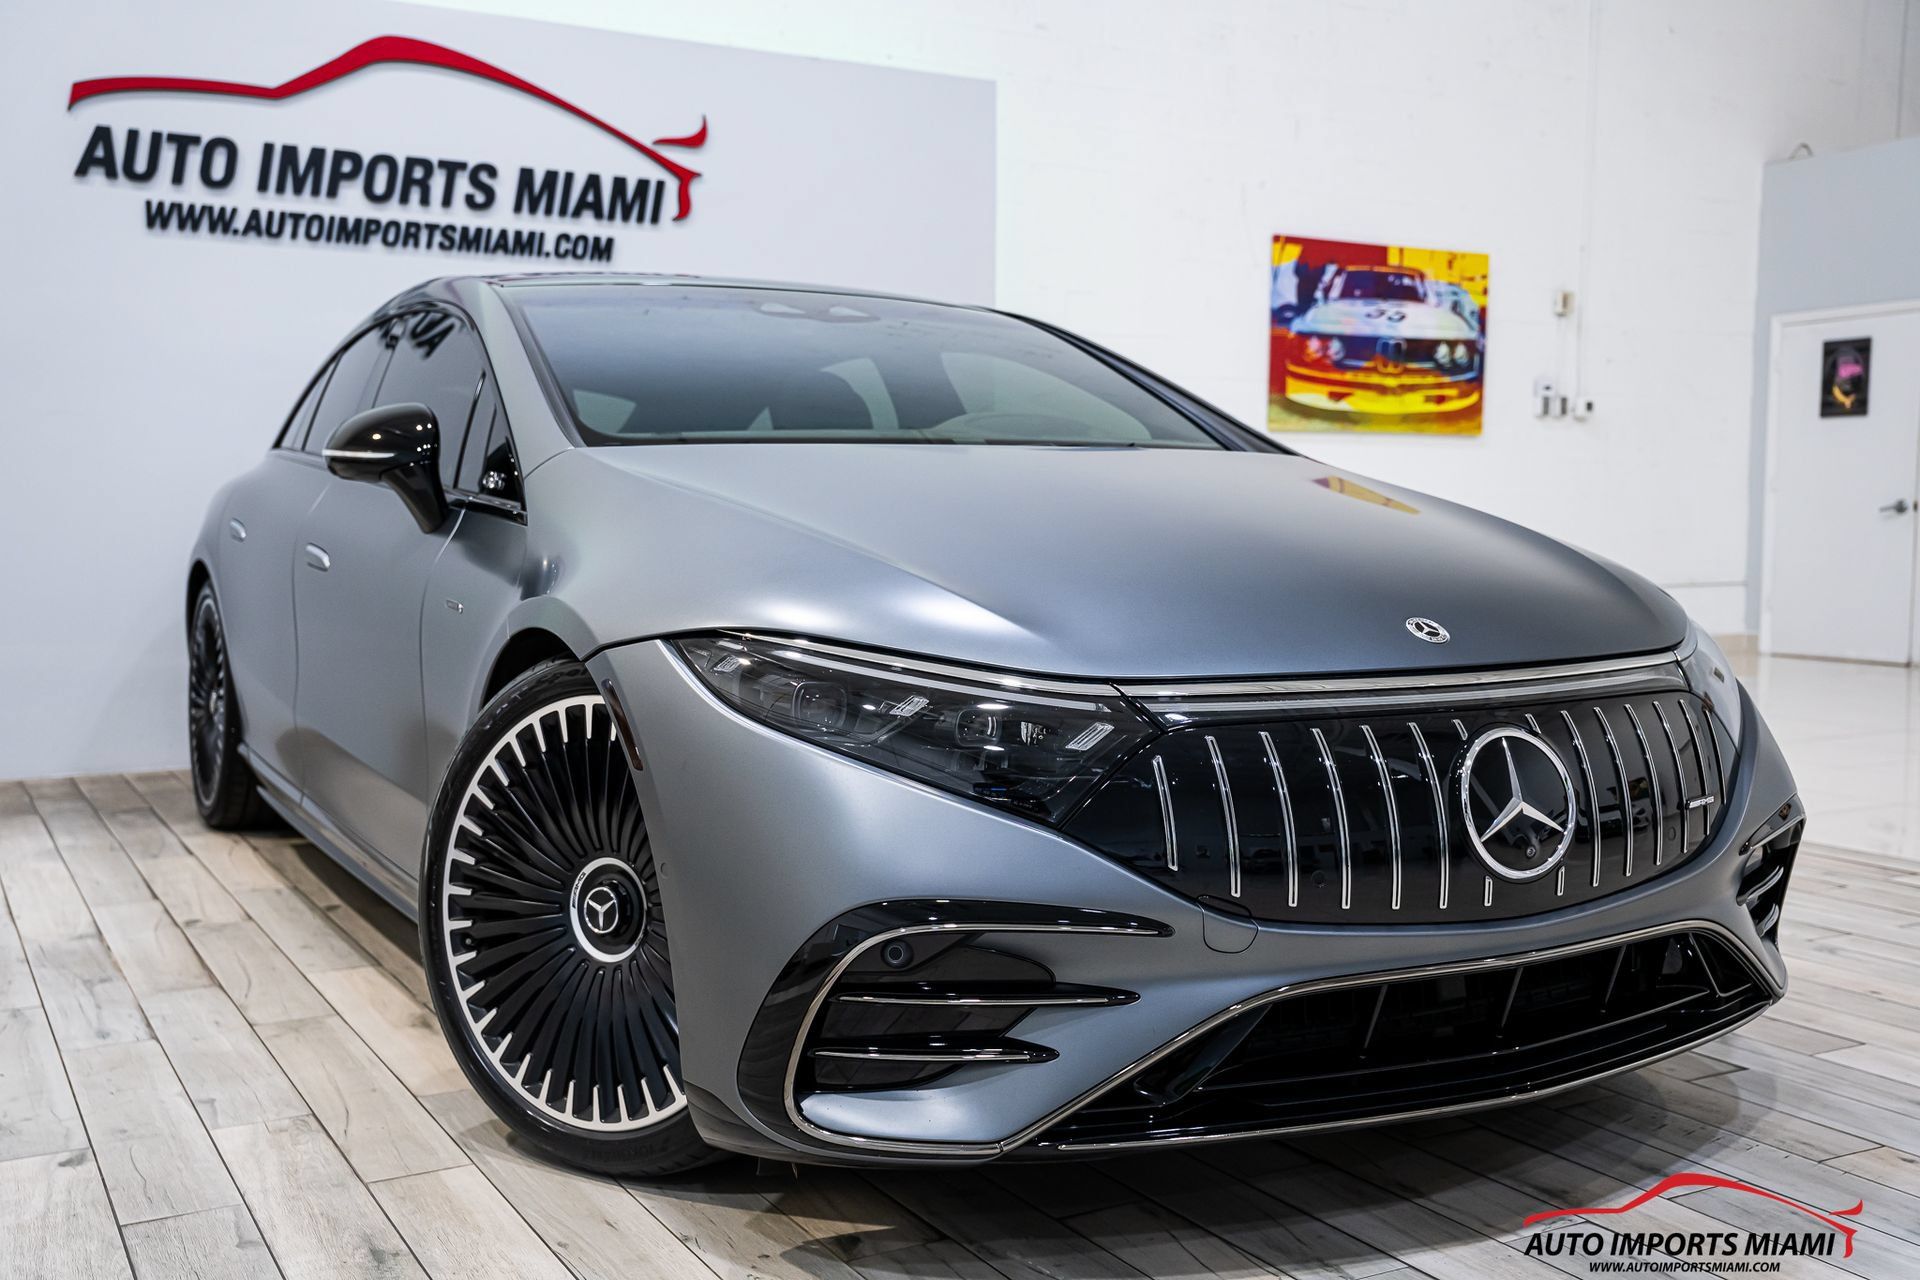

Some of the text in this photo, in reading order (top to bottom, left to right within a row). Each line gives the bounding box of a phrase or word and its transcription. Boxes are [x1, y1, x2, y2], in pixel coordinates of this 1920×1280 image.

[75, 126, 667, 225] AUTO IMPORTS MIAMI
[145, 200, 615, 263] WWW.AUTOIMPORTSMIAMI.COM
